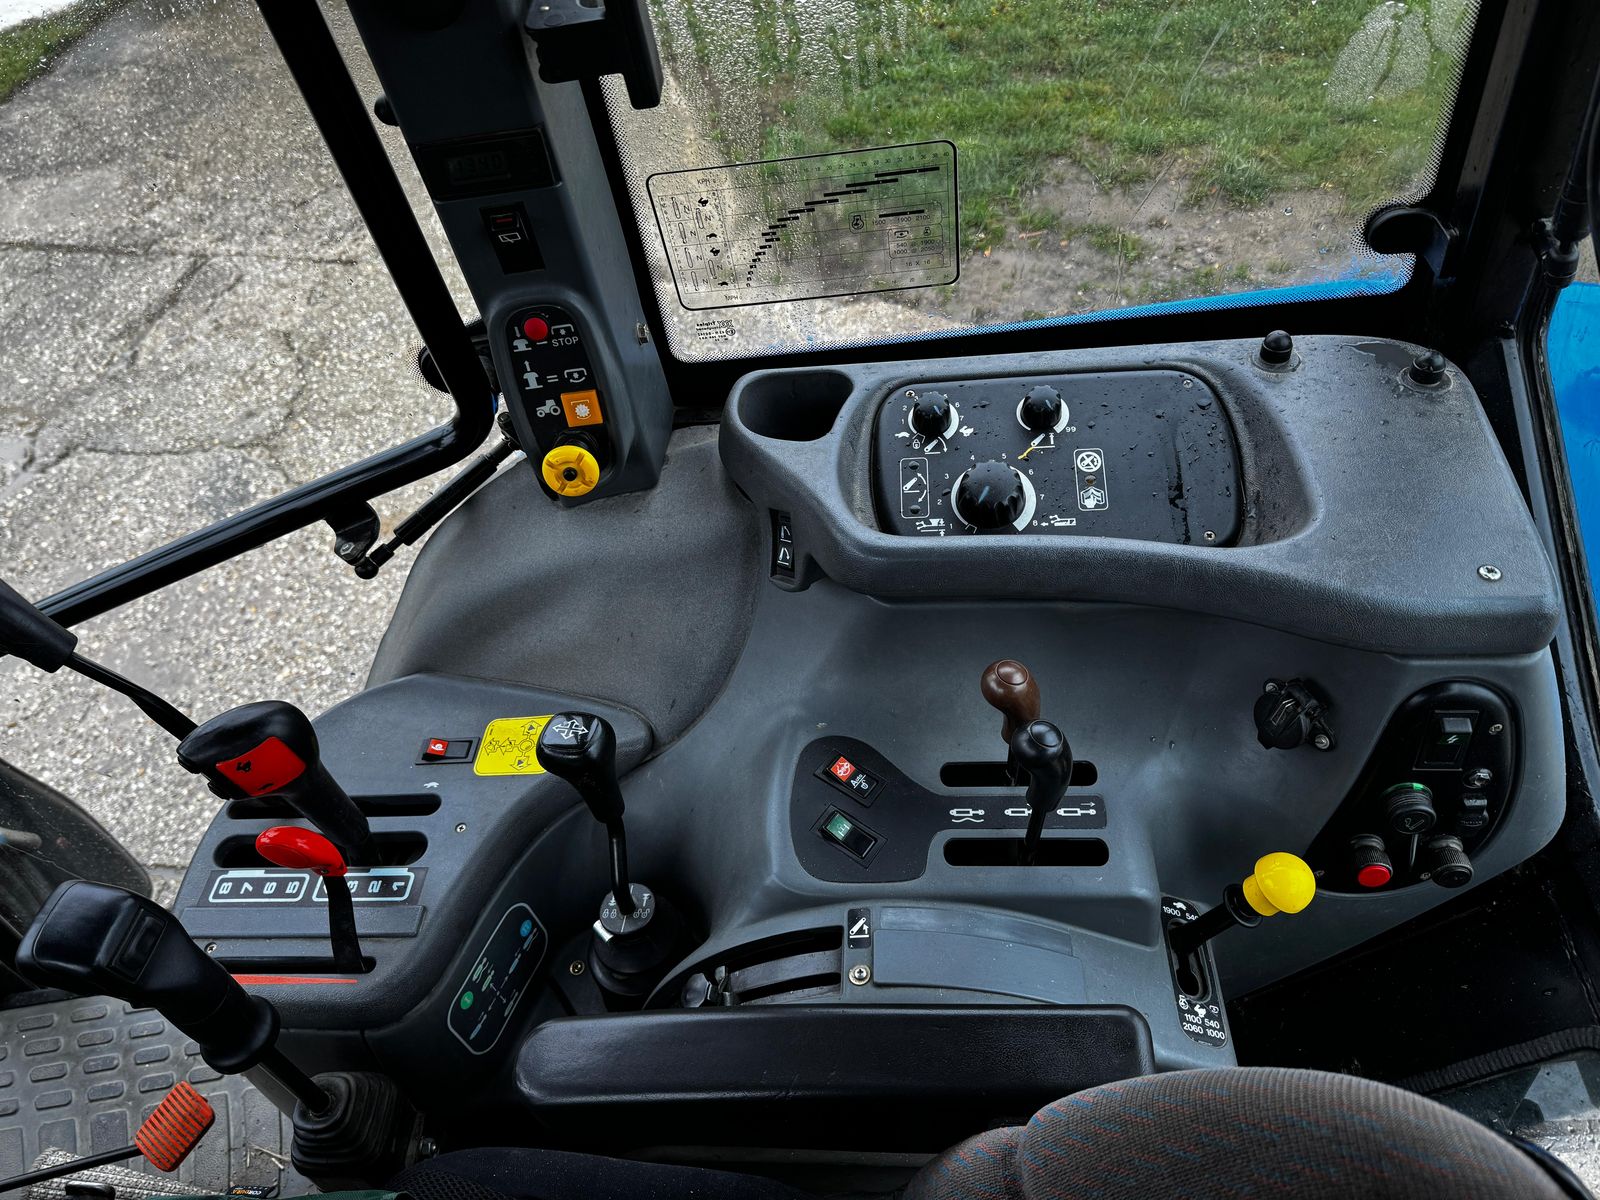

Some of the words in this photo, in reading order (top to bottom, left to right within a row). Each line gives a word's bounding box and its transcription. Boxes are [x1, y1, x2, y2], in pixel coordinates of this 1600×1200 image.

[552, 336, 579, 347] STOP
[851, 774, 863, 787] Auto
[218, 882, 232, 894] 8
[240, 882, 253, 894] 7
[263, 882, 277, 894] 6
[285, 881, 300, 894] 5
[368, 880, 382, 893] 2
[392, 882, 405, 891] 1
[1163, 906, 1181, 917] 1900
[1184, 1013, 1201, 1024] 1100
[1204, 1018, 1220, 1029] 540
[1182, 1022, 1204, 1034] 2060
[1206, 1028, 1225, 1040] 1000
